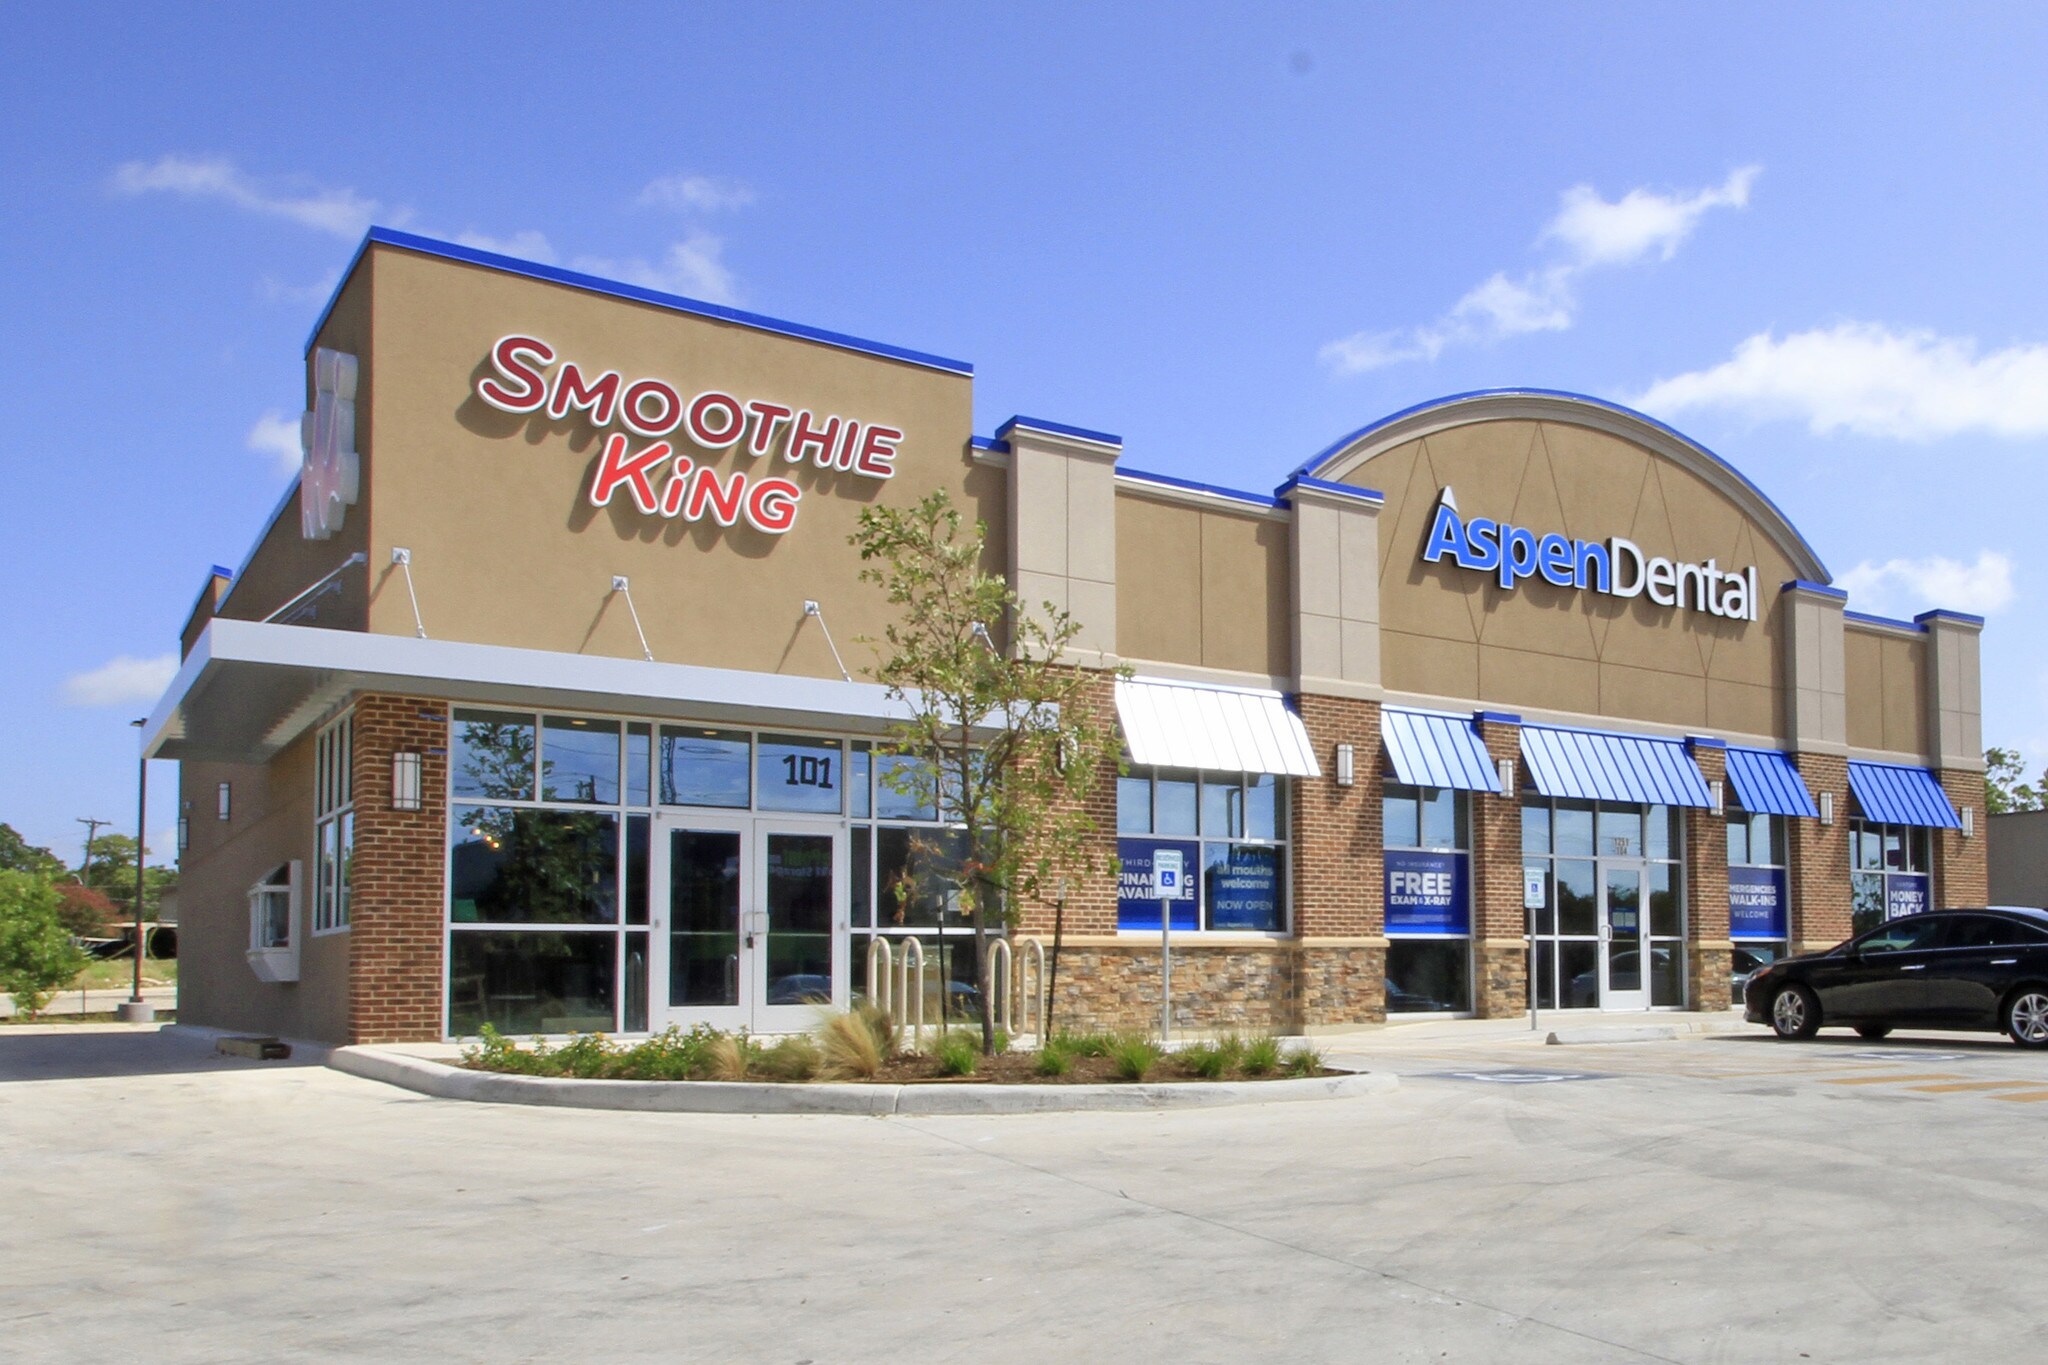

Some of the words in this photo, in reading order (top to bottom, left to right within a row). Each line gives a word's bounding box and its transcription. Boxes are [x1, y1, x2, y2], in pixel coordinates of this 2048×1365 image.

[478, 334, 902, 478] SMOOTHIE
[783, 754, 833, 789] 101
[1221, 877, 1270, 889] welcome
[1390, 871, 1452, 895] FREE
[1390, 895, 1418, 905] EXAM
[1729, 894, 1777, 906] WALK-INS
[1889, 890, 1924, 903] MONEY
[1216, 900, 1243, 910] NOW
[1245, 900, 1273, 910] OPEN
[1734, 910, 1769, 919] WELCOME
